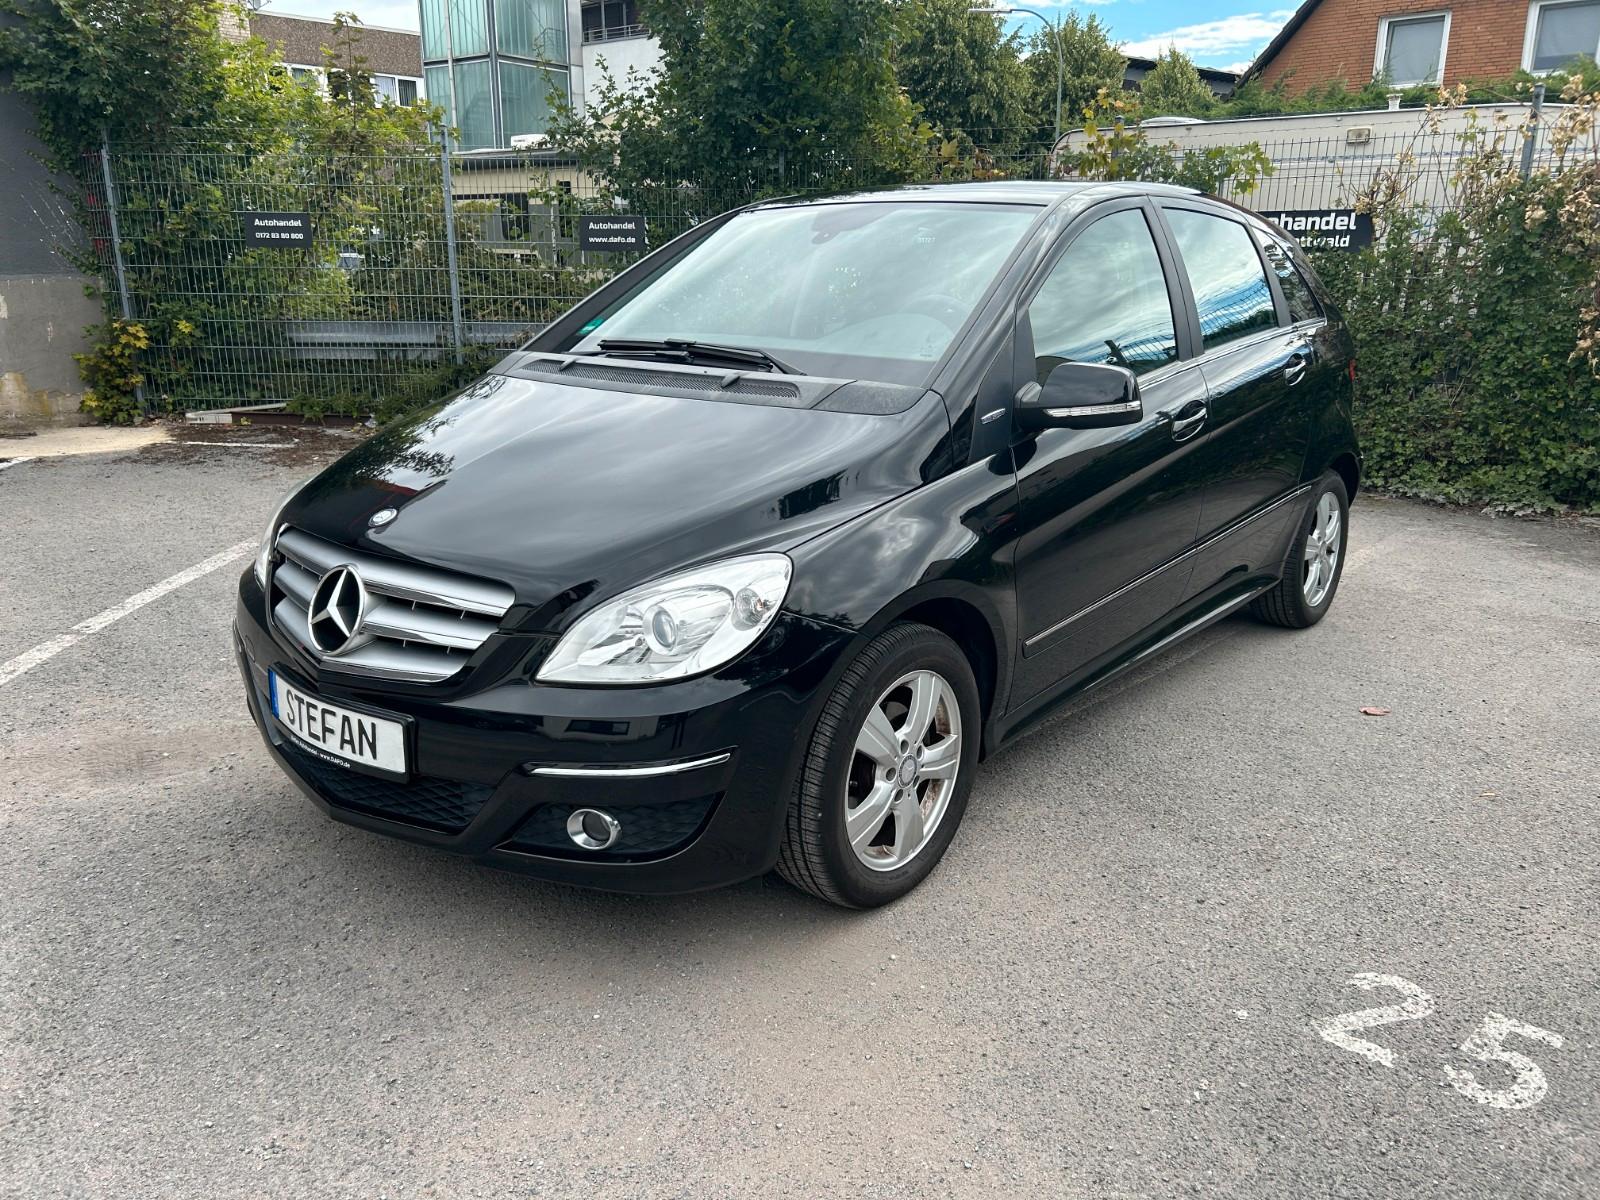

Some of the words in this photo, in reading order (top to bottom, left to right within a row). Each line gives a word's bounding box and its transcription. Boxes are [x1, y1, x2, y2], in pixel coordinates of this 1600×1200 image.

[254, 218, 303, 227] Autohandel
[588, 221, 636, 230] Autohandel
[1295, 235, 1350, 248] ttwald
[286, 689, 377, 760] STEFAN
